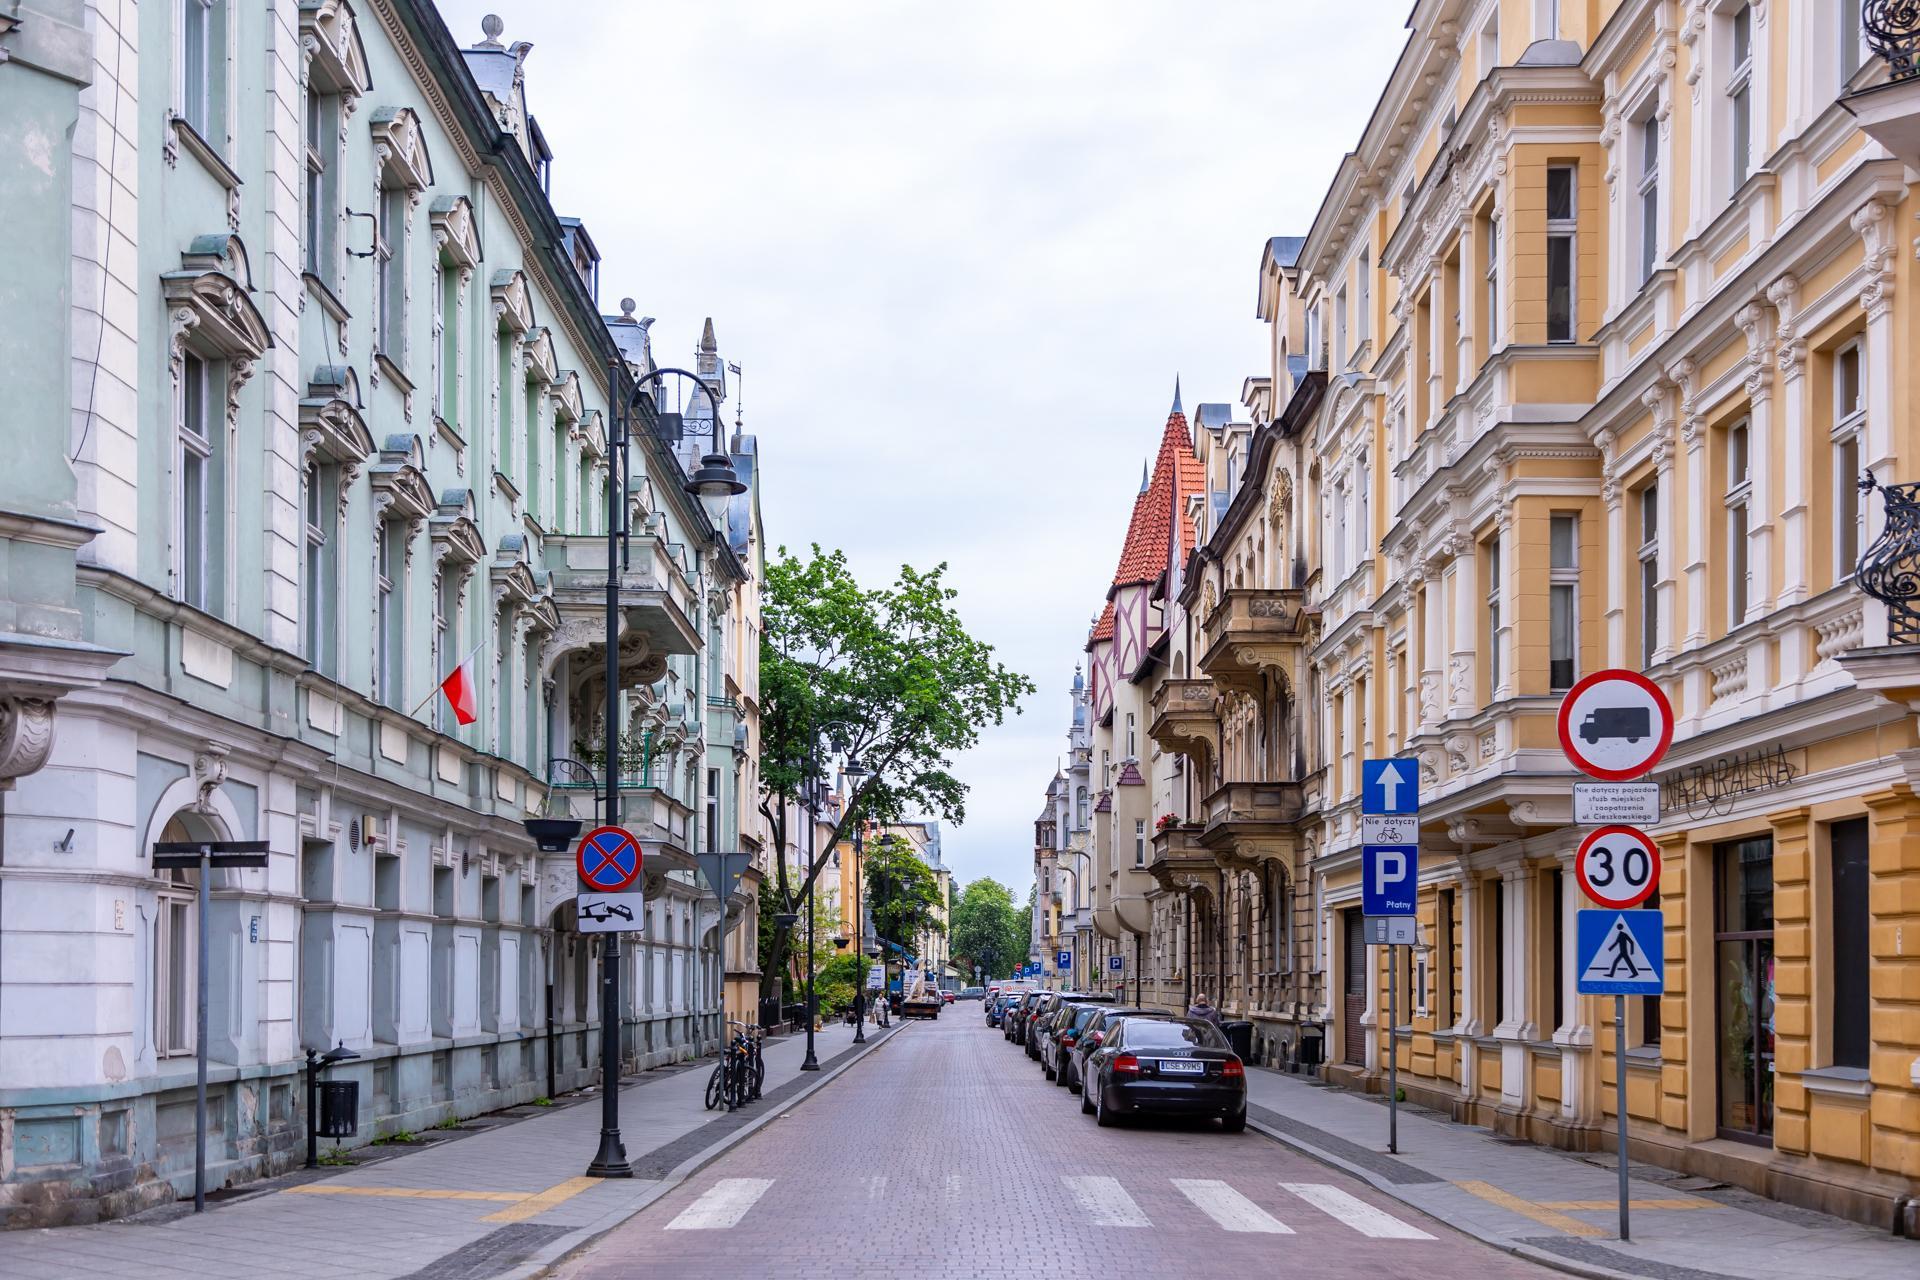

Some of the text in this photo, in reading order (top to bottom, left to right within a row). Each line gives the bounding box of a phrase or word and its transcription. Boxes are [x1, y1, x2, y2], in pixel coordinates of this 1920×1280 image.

[1665, 743, 1792, 812] NATURALNA
[1611, 795, 1645, 803] miejskich
[1595, 804, 1644, 812] zaopatrzenia
[1593, 813, 1652, 821] Cieszkowskiego
[1384, 818, 1416, 827] dotyczy
[1589, 846, 1649, 887] 30
[1375, 851, 1407, 895] P
[1386, 900, 1412, 910] Płatny
[1060, 953, 1069, 964] P
[1112, 958, 1120, 968] P
[1033, 963, 1040, 971] P
